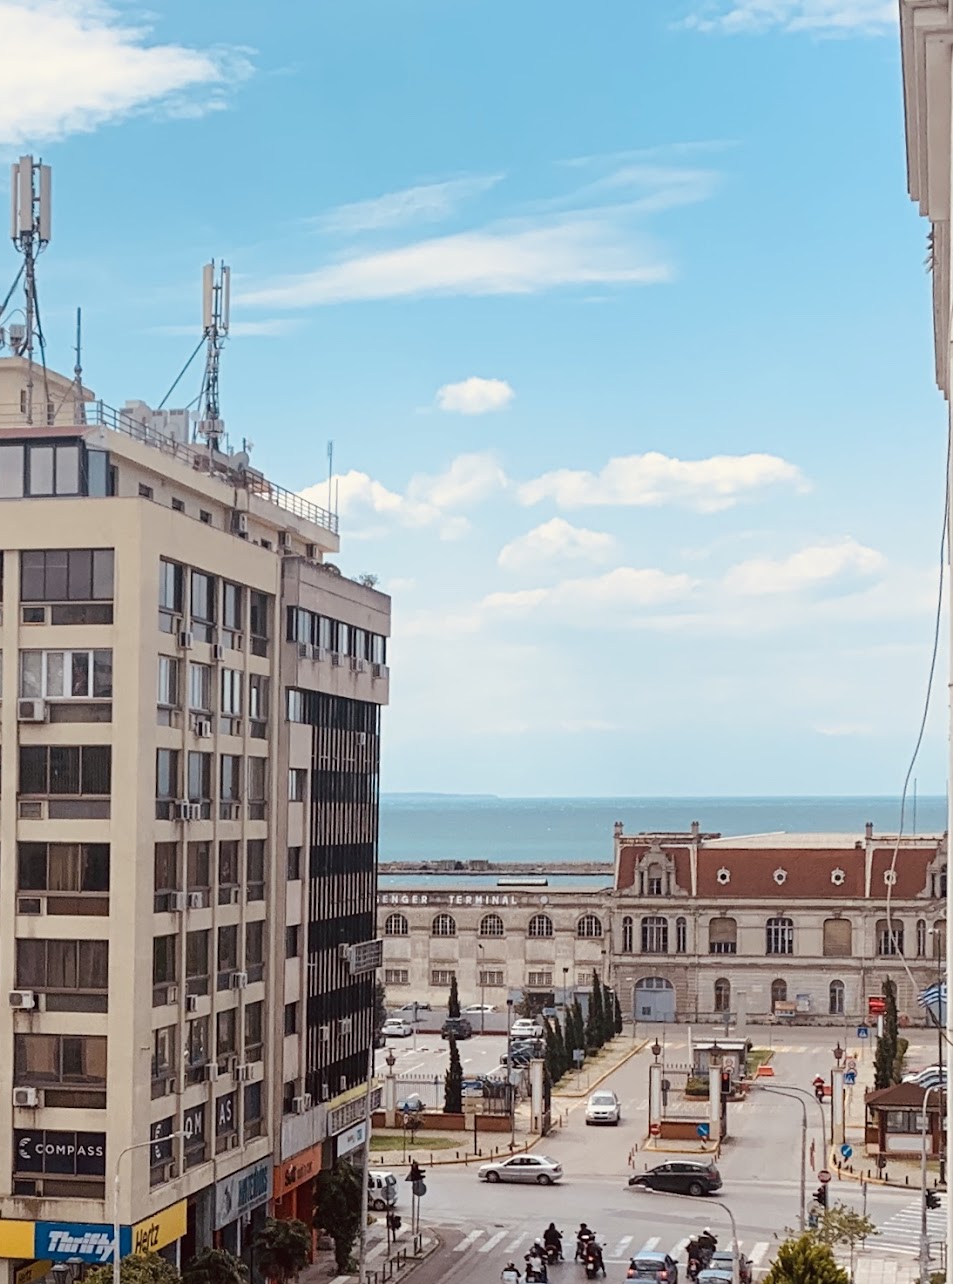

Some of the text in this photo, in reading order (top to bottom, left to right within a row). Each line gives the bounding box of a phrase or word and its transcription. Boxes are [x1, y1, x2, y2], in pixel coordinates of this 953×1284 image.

[449, 895, 517, 905] TERMINAL
[35, 1143, 104, 1157] COMPASS
[48, 1230, 116, 1262] Thrifty
[135, 1222, 160, 1255] Hertz
